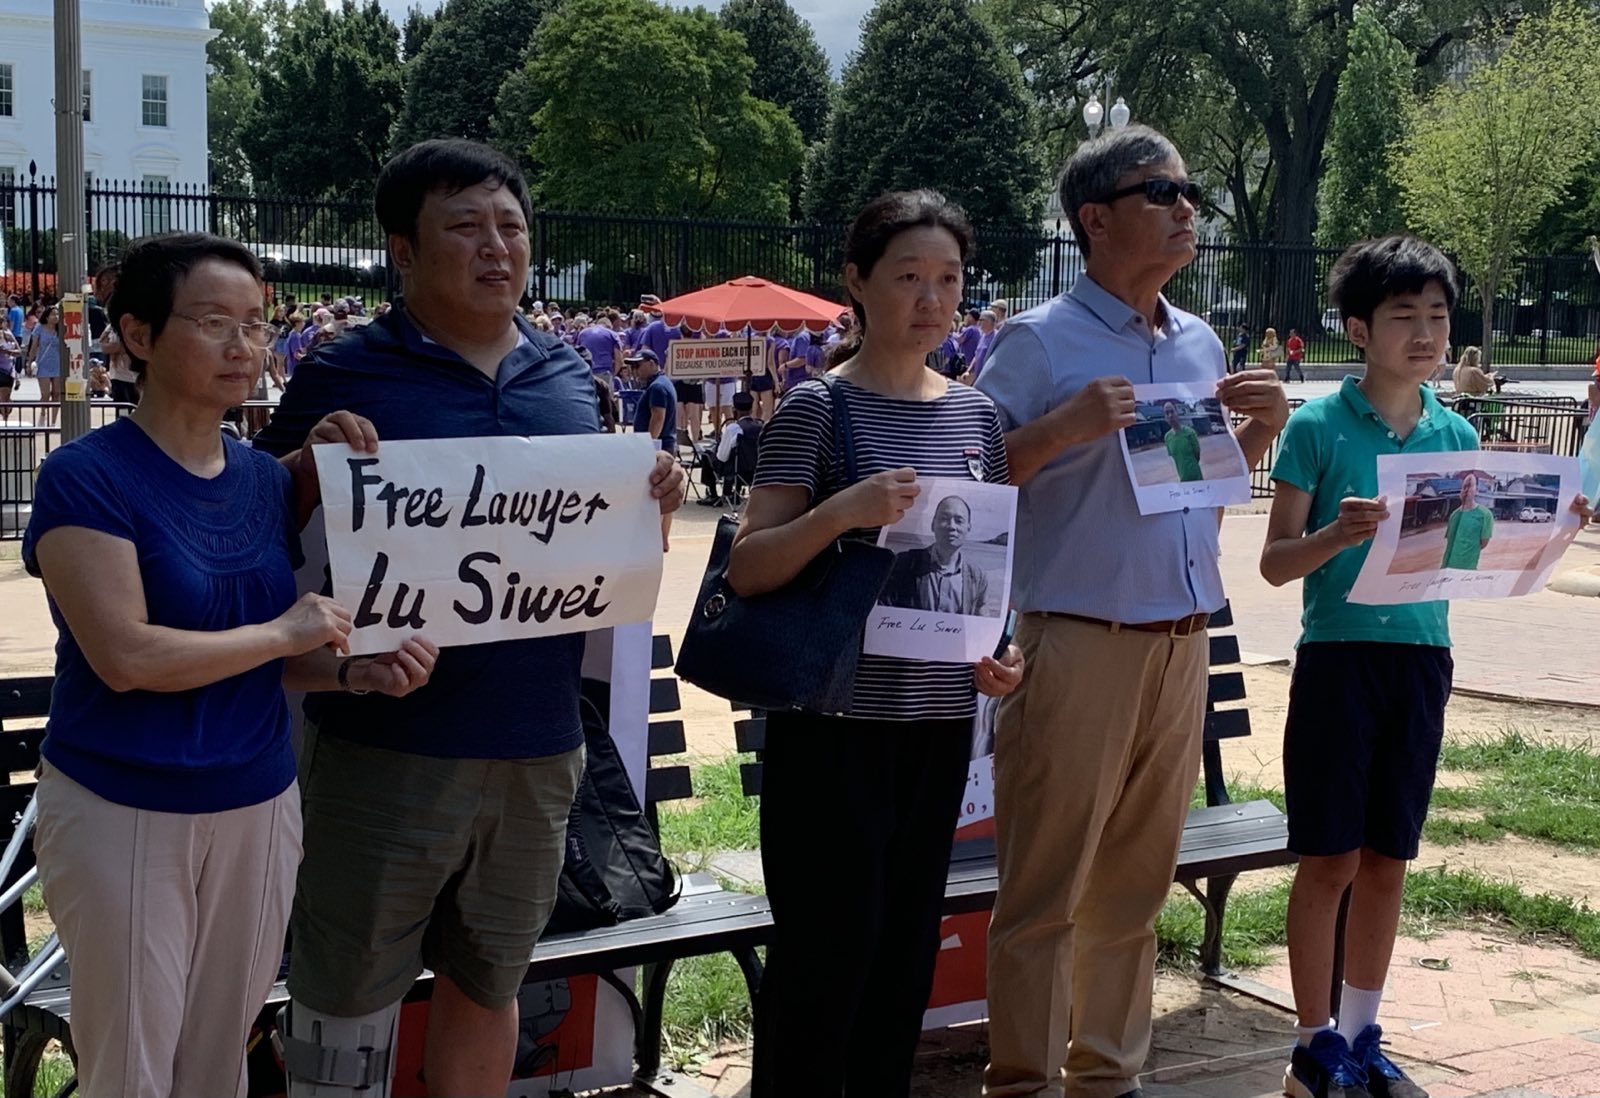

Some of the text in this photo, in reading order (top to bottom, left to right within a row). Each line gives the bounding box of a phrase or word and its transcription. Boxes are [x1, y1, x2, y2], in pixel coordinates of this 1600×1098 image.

[676, 345, 760, 359] STOP HATING EACH OTER
[675, 360, 703, 370] BECAUSE
[704, 359, 717, 369] YOU
[347, 458, 610, 545] Free Lawyer
[354, 552, 611, 629] Lu Siwei
[877, 616, 902, 630] Free
[909, 616, 927, 632] Lu
